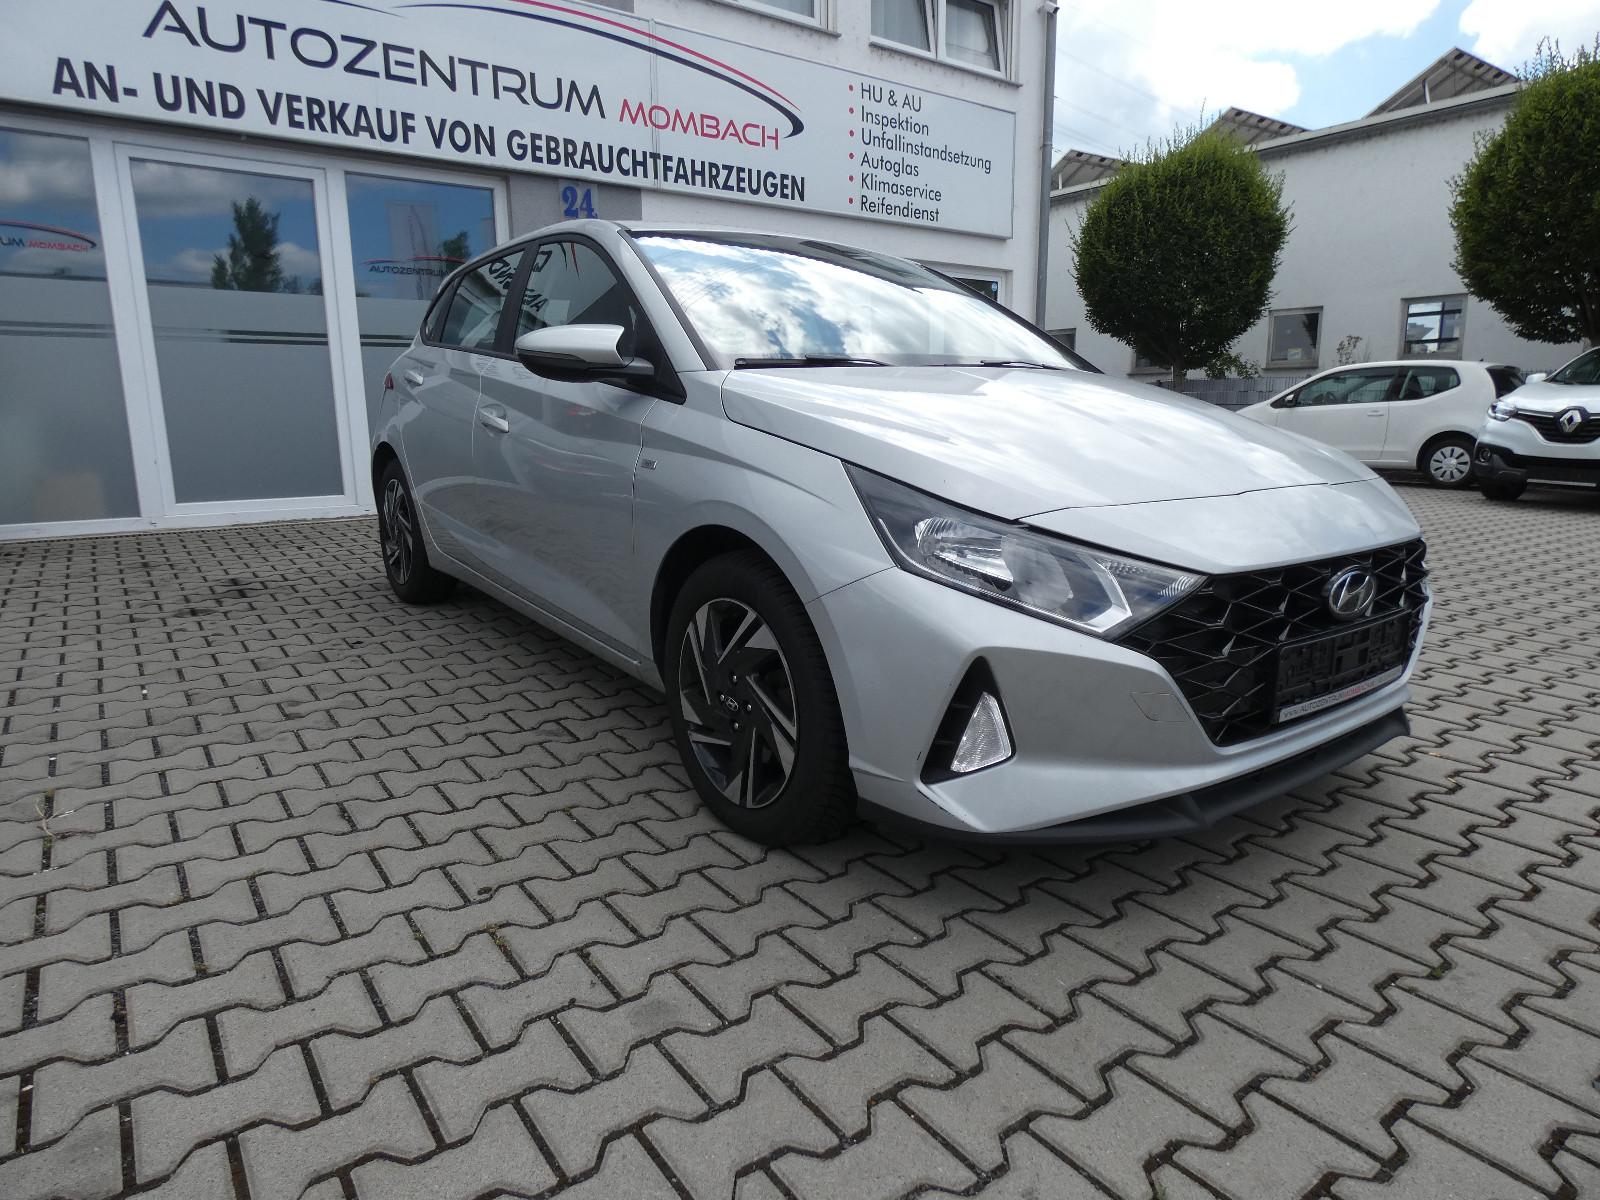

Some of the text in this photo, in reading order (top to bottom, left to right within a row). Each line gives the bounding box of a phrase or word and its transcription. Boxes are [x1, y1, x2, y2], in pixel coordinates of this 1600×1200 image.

[142, 0, 779, 150] AUTOZENTRUM MOMBACH
[861, 82, 922, 112] HU & AU
[52, 57, 805, 202] AN- UND VERKAUF VON GEBRAUCHTFAHRZEUGEN
[861, 105, 929, 136] Inspektion
[860, 151, 919, 177] Autoglas
[861, 127, 992, 174] Unfallinstandsetzung
[861, 172, 942, 201] Klimaservice
[861, 195, 940, 222] Reifendienst
[29, 240, 88, 252] MOMBACH
